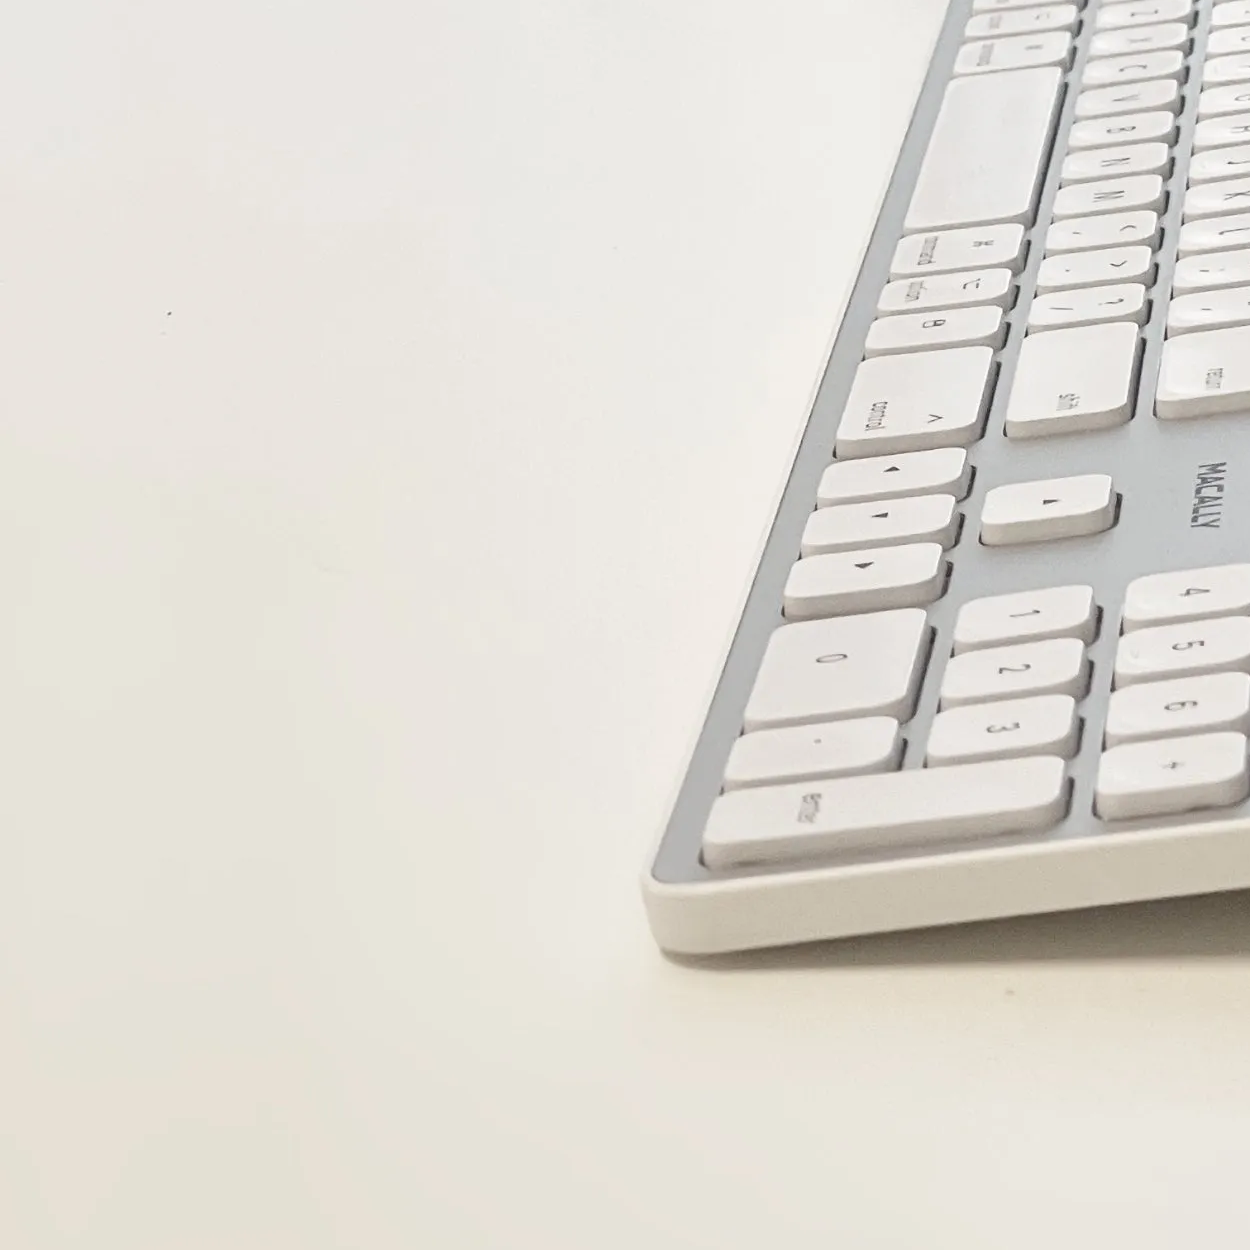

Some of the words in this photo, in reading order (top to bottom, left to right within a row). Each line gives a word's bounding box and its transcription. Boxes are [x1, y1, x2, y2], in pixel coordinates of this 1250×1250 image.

[1101, 157, 1132, 168] N
[1094, 190, 1125, 202] M
[1191, 462, 1227, 528] MACALLY
[1179, 587, 1211, 597] 4
[1171, 640, 1205, 651] 5
[998, 663, 1032, 675] 2
[1163, 700, 1199, 711] 6
[985, 721, 1021, 734] 3
